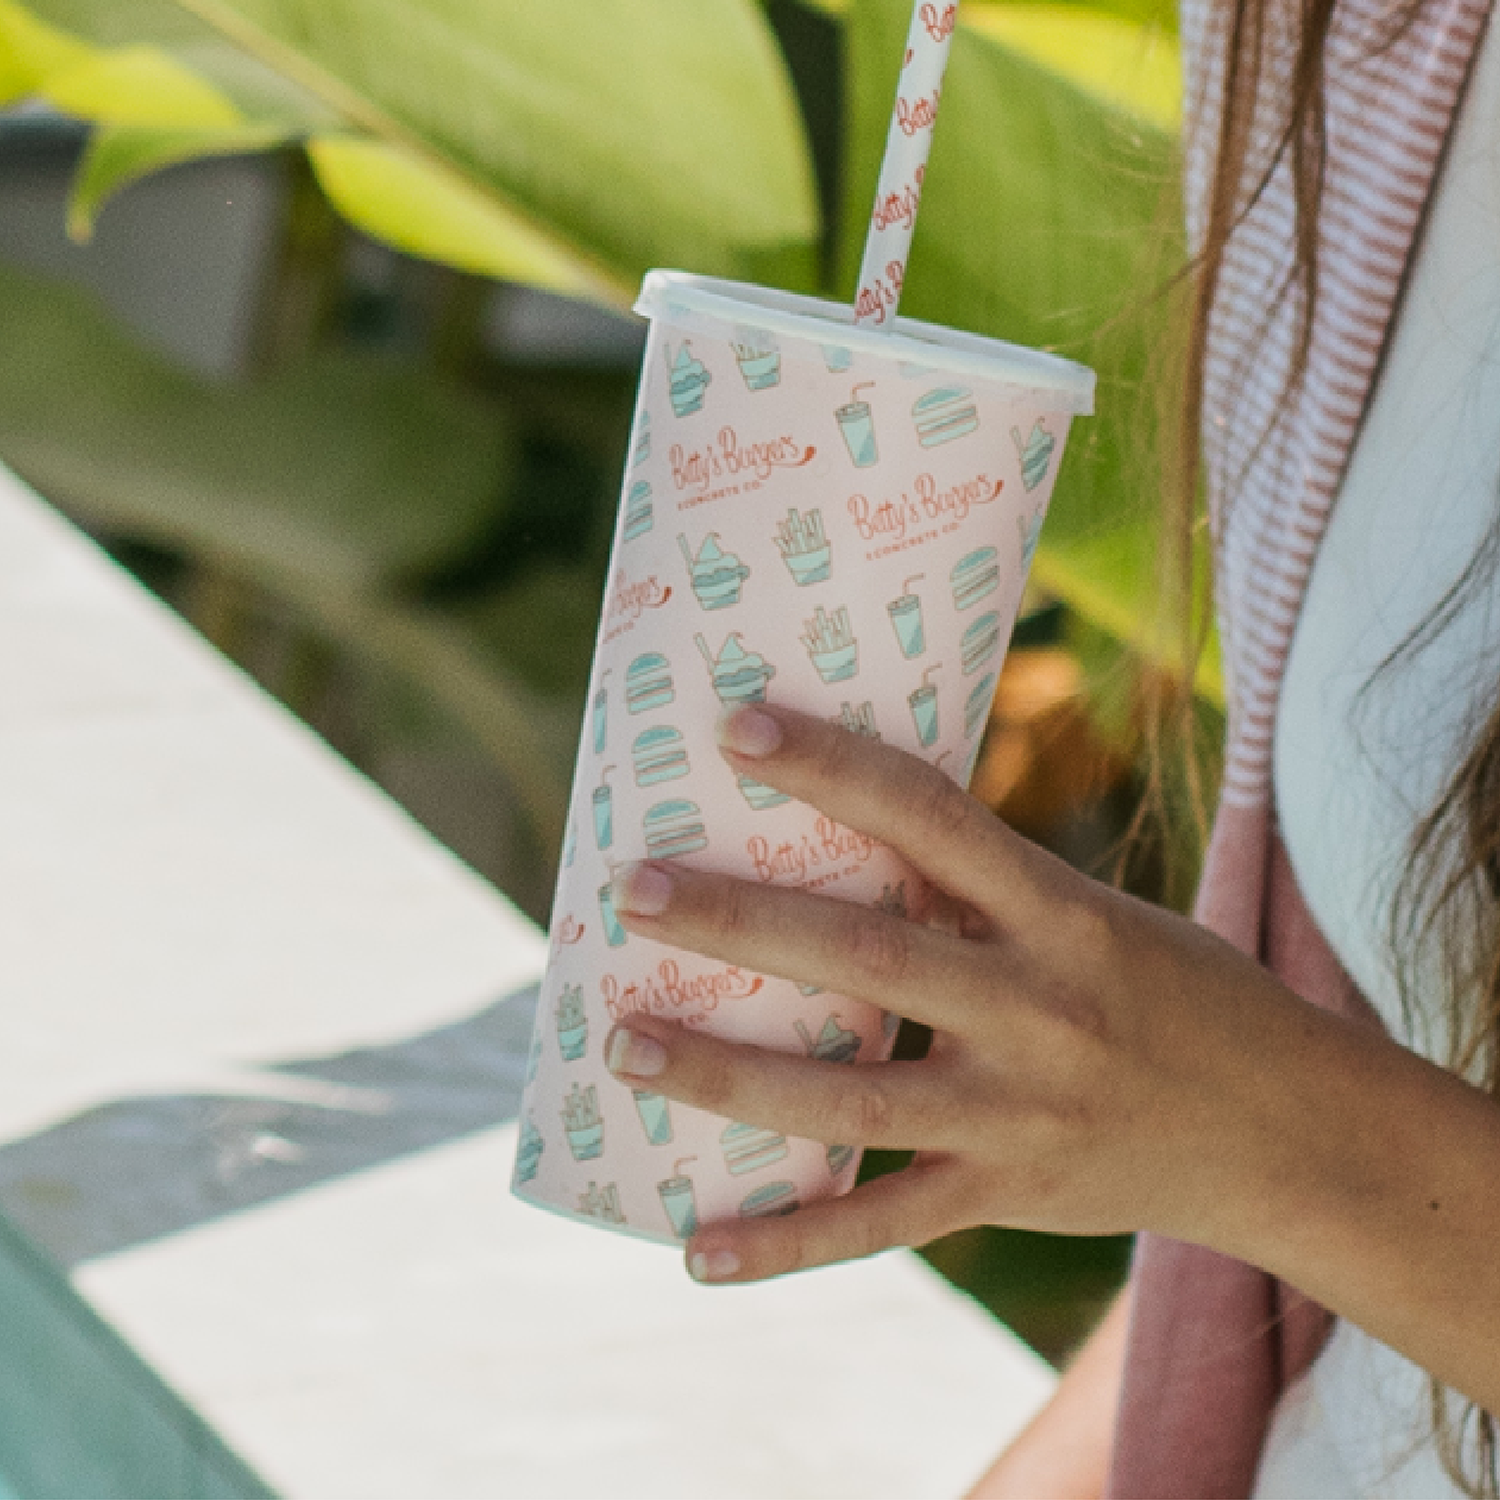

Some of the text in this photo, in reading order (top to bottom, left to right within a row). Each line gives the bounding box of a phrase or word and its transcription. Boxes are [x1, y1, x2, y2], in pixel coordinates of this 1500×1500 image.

[669, 425, 817, 492] Betty's Burgers
[847, 472, 1005, 540] Betty's Burgers
[746, 835, 820, 882] Betty's
[600, 958, 765, 1020] Betty's Burgers
